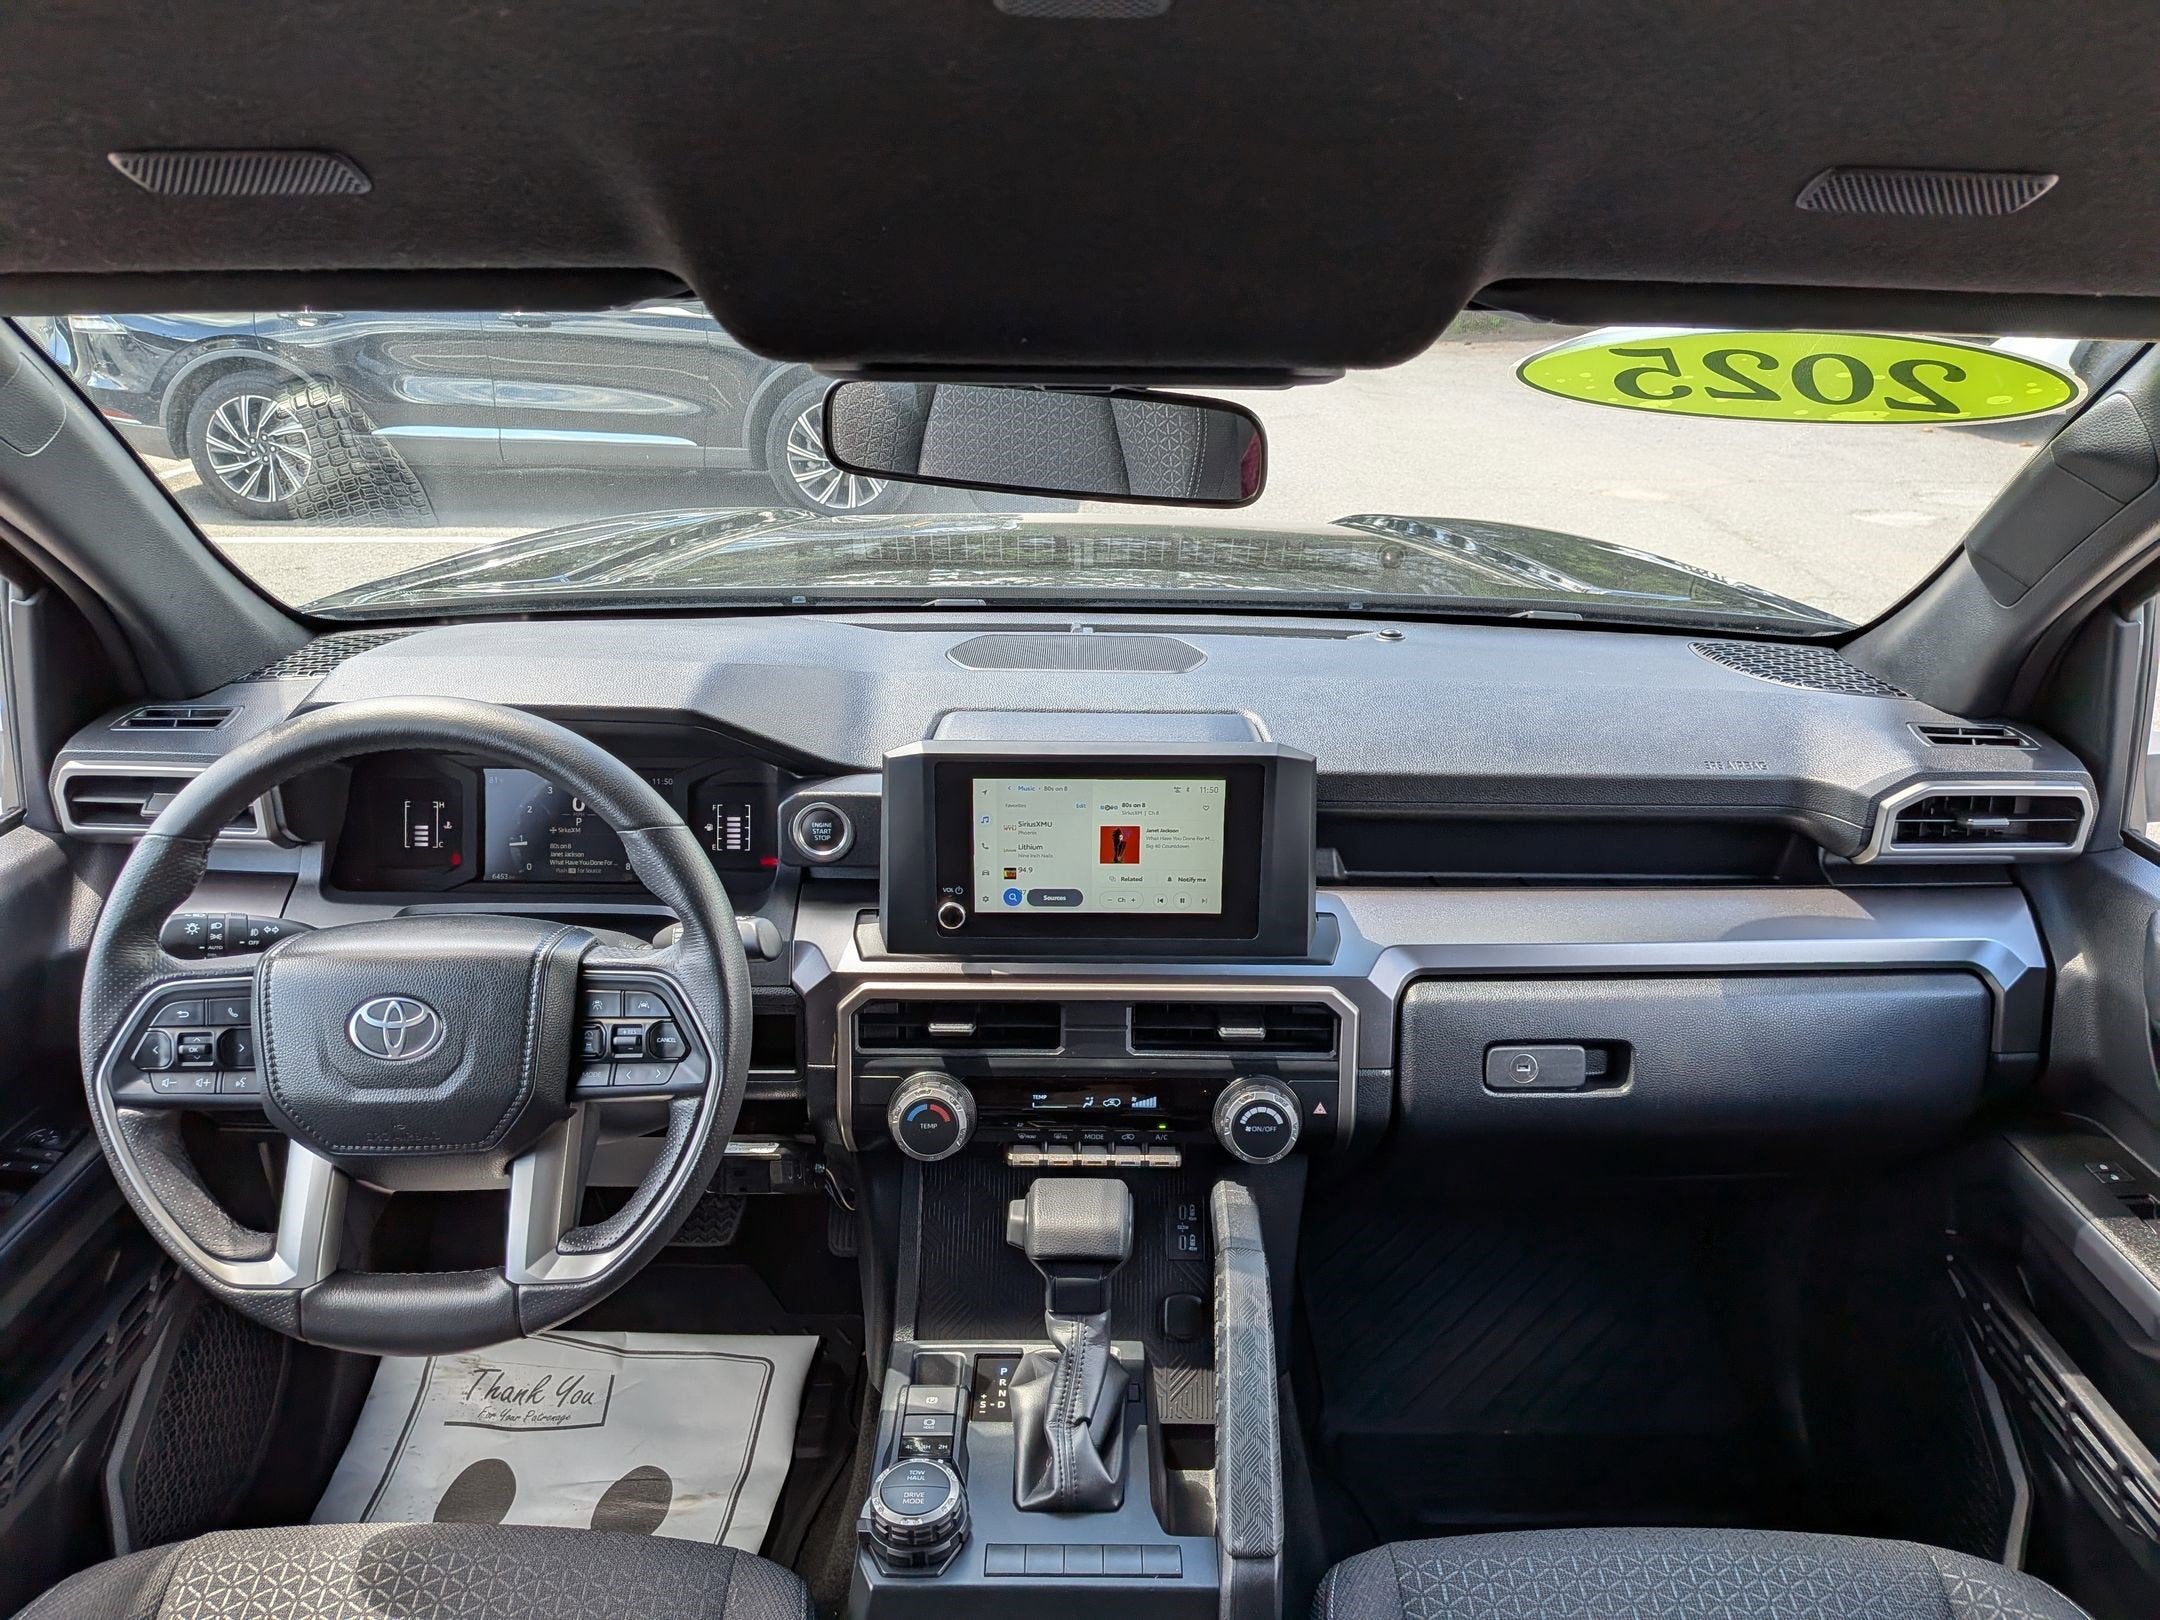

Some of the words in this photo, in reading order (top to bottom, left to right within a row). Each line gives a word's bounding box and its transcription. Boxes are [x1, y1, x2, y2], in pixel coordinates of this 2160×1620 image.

[1727, 761, 1768, 770] AIRBAG
[652, 778, 674, 786] 11:50
[547, 786, 553, 794] 3
[1199, 786, 1219, 794] 11:50
[527, 805, 533, 814] 2
[576, 818, 582, 826] P
[526, 863, 532, 871] 0
[625, 863, 631, 871] 8
[1018, 866, 1033, 874] 94.9
[1178, 876, 1196, 884] Notify
[1000, 1367, 1008, 1376] P
[999, 1378, 1007, 1386] R
[466, 1368, 552, 1406] Thank
[556, 1374, 594, 1408] You
[998, 1389, 1007, 1397] N
[979, 1400, 987, 1409] S
[997, 1400, 1006, 1409] D
[477, 1406, 497, 1419] For
[499, 1408, 521, 1422] Your
[523, 1409, 571, 1425] Patronage
